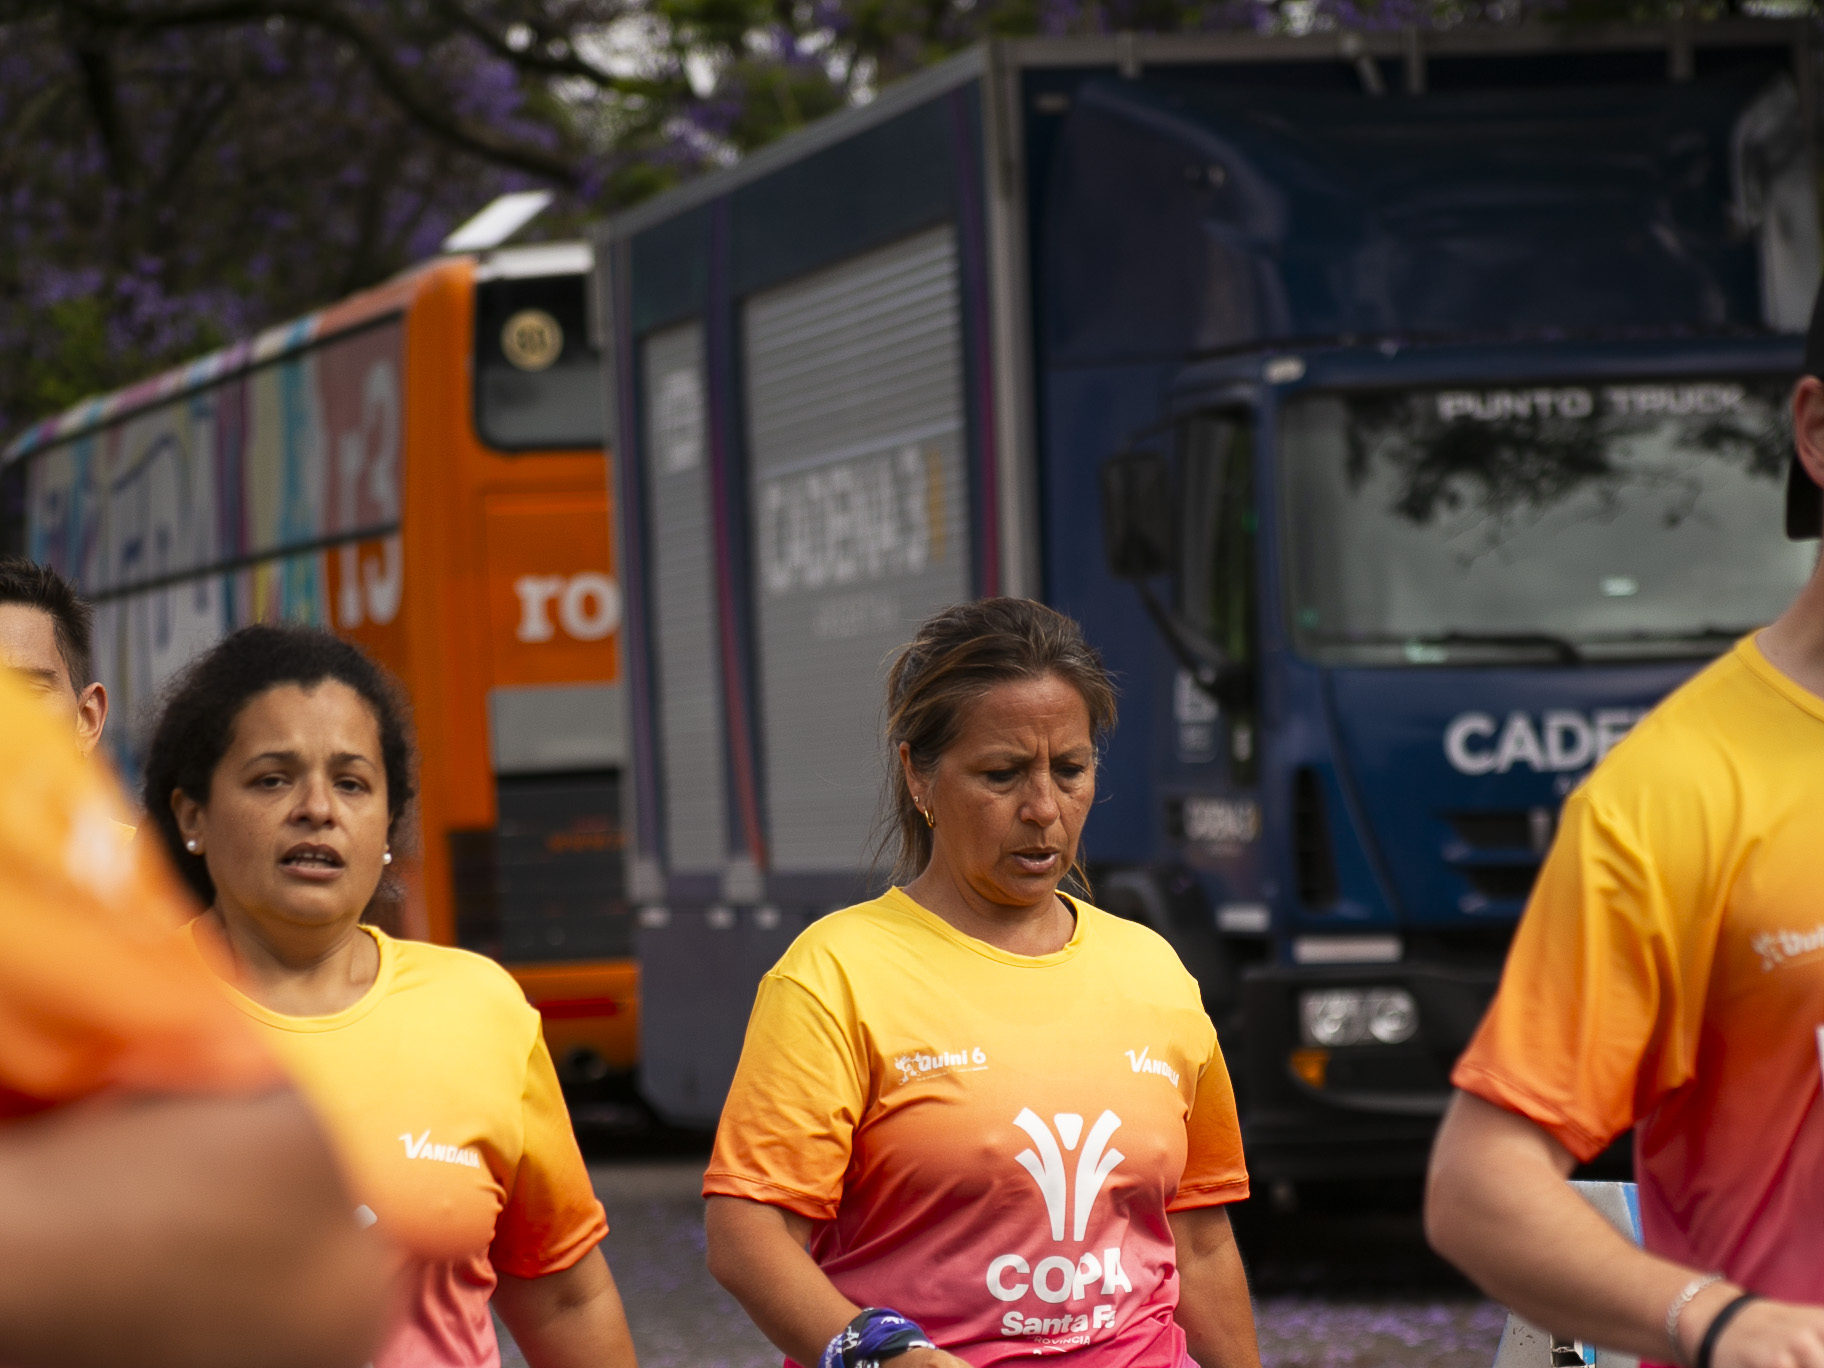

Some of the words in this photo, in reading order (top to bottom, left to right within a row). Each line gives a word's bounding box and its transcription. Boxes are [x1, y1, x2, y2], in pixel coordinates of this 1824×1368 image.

[1437, 388, 1594, 420] PUNTO
[513, 571, 622, 642] ro
[1444, 711, 1650, 775] CADE
[918, 1050, 968, 1072] Quini
[971, 1047, 987, 1065] 6
[986, 1247, 1133, 1304] COPA
[1001, 1311, 1089, 1337] Santa
[1027, 1335, 1092, 1346] PROVINCIA
